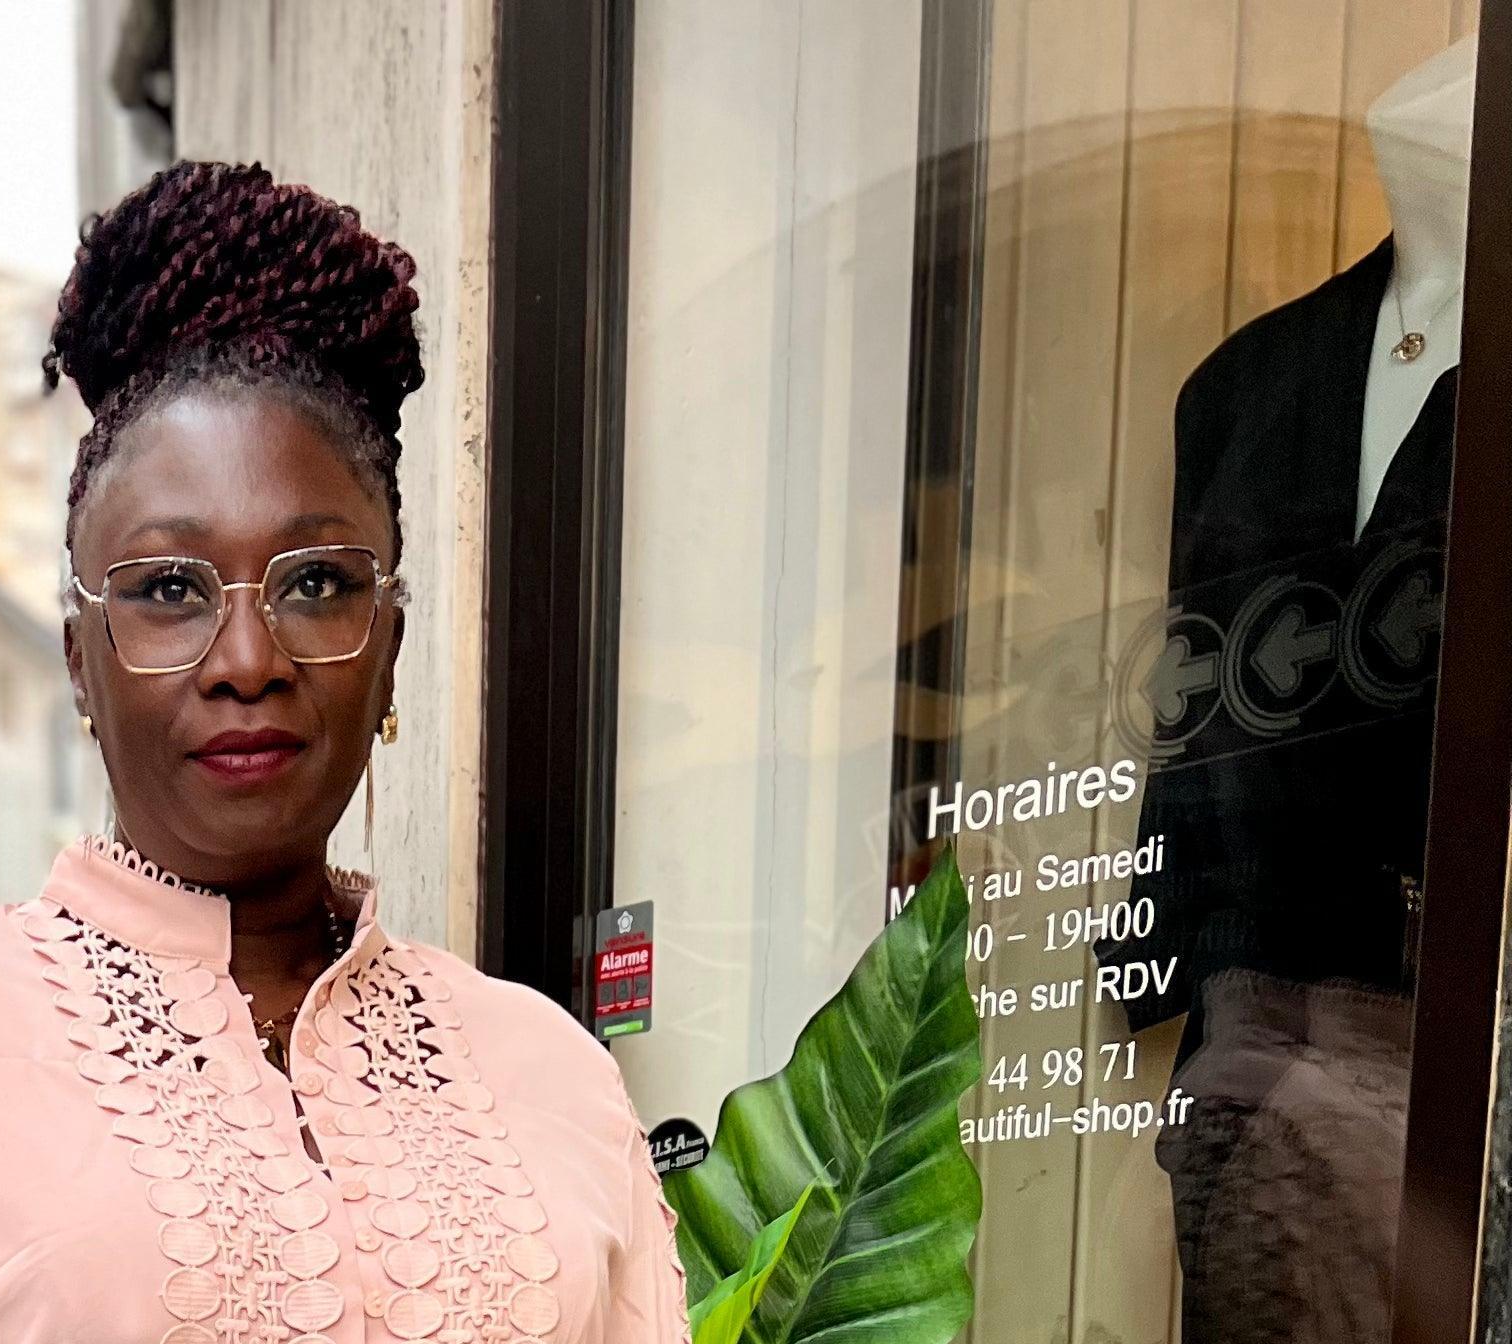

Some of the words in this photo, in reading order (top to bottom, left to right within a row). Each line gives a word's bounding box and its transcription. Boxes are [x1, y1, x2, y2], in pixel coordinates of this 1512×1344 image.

[927, 759, 1137, 839] Horaires
[983, 868, 1021, 902] au
[1036, 835, 1165, 893] Samedi
[1043, 897, 1155, 953] 19H00
[600, 949, 648, 972] Alarme
[1030, 978, 1083, 1013] sur
[1095, 956, 1178, 1004] RDV
[988, 1053, 1028, 1094] 44
[1041, 1046, 1084, 1090] 98
[1099, 1040, 1137, 1082] 71
[960, 1088, 1194, 1145] autiful-shop.fr
